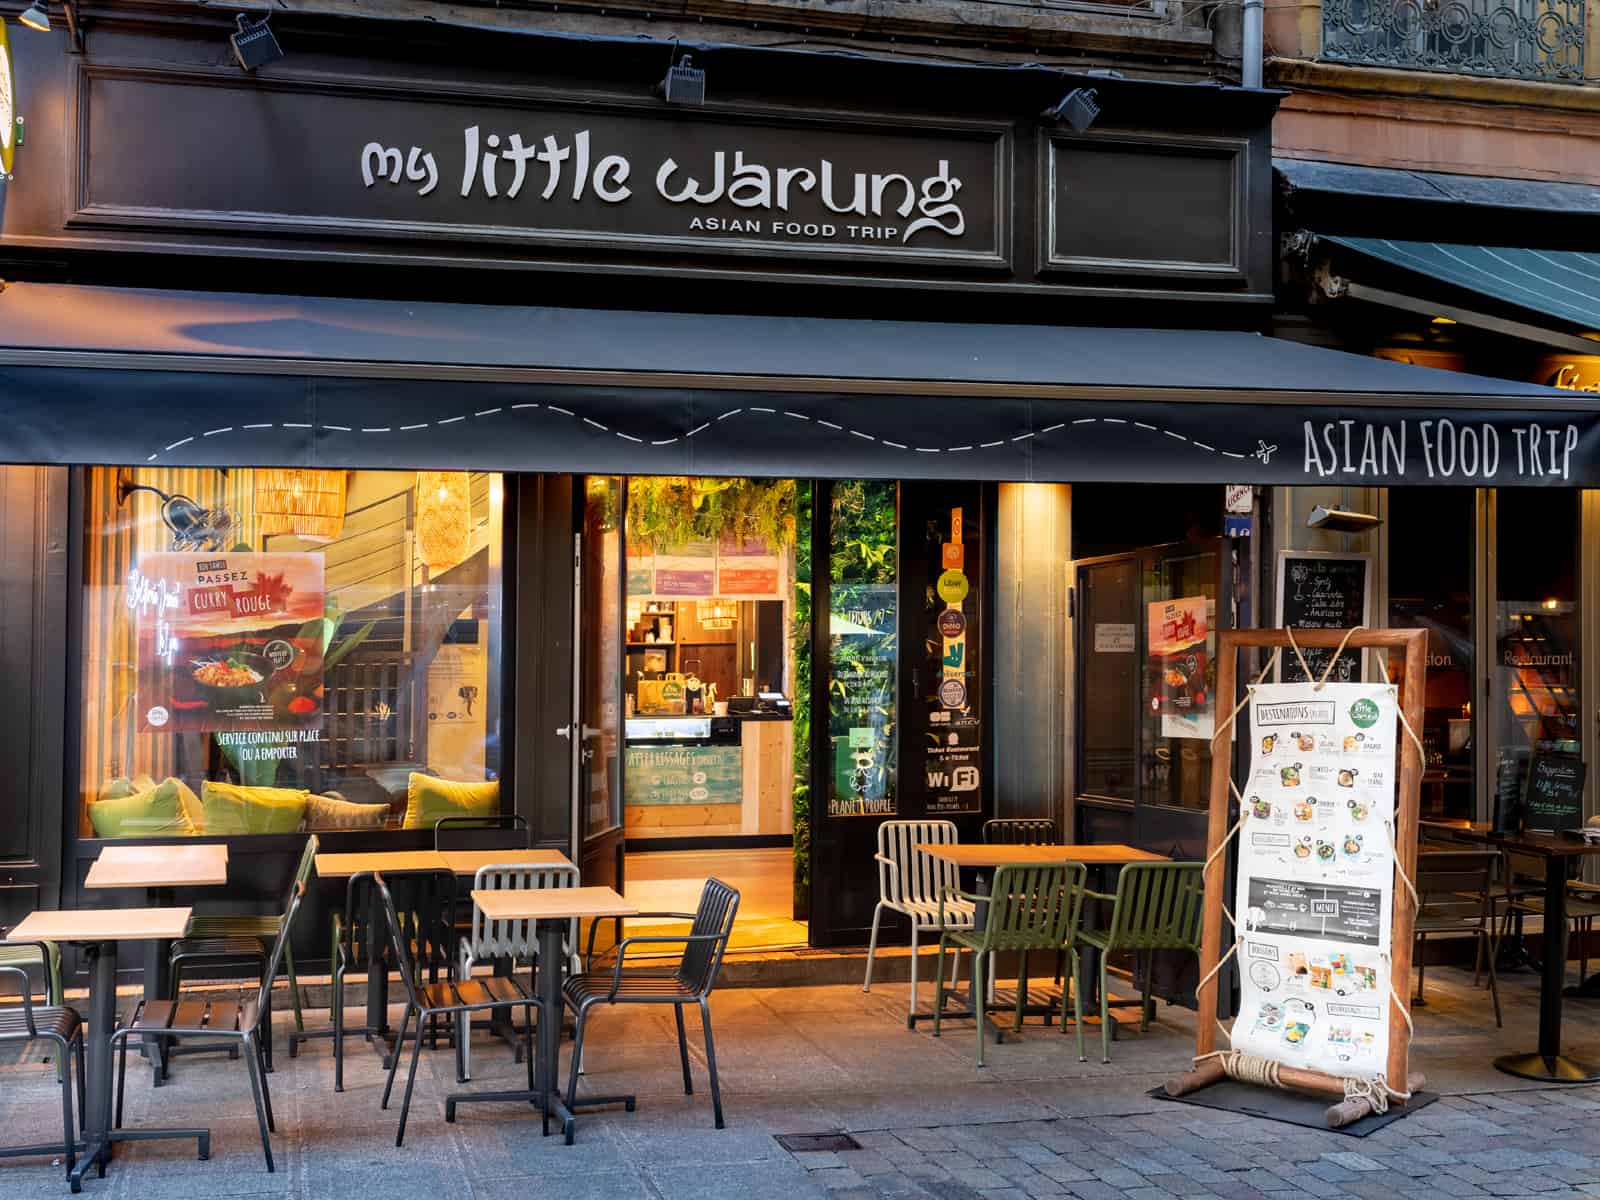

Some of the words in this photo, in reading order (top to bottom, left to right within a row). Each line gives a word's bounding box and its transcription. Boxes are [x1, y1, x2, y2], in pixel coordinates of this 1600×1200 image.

[361, 141, 439, 196] my
[460, 125, 633, 203] little
[655, 150, 966, 244] warung
[689, 216, 761, 235] ASIAN
[771, 221, 836, 238] FOOD
[845, 224, 898, 241] TRIP
[1303, 419, 1406, 477] ASIAN
[1419, 418, 1500, 478] FOOD
[1511, 423, 1579, 480] TRIP
[198, 571, 249, 584] PASSEZ
[194, 591, 227, 609] CURRY
[236, 594, 272, 613] ROUGE
[217, 731, 247, 745] SERVICE
[247, 730, 284, 744] CONTINU
[284, 729, 298, 742] SUR
[299, 728, 320, 742] PLACE
[261, 746, 298, 760] EMPORTER
